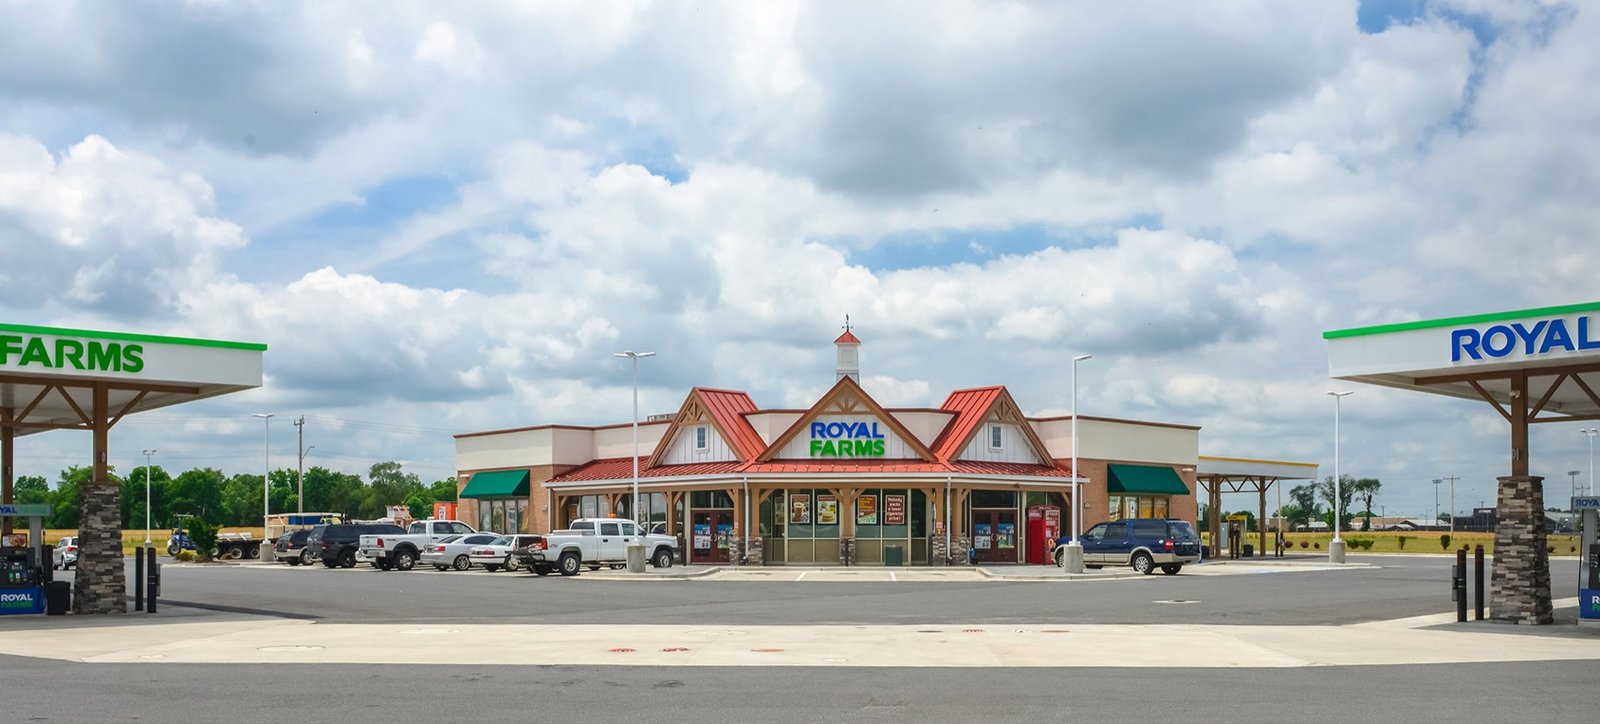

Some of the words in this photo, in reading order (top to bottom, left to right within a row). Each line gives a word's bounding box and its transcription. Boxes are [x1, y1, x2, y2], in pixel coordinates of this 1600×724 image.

[1451, 316, 1600, 362] ROYAL
[0, 335, 144, 373] FARMS
[810, 422, 885, 439] ROYAL
[810, 440, 885, 457] FARMS
[1, 594, 33, 602] ROYAL
